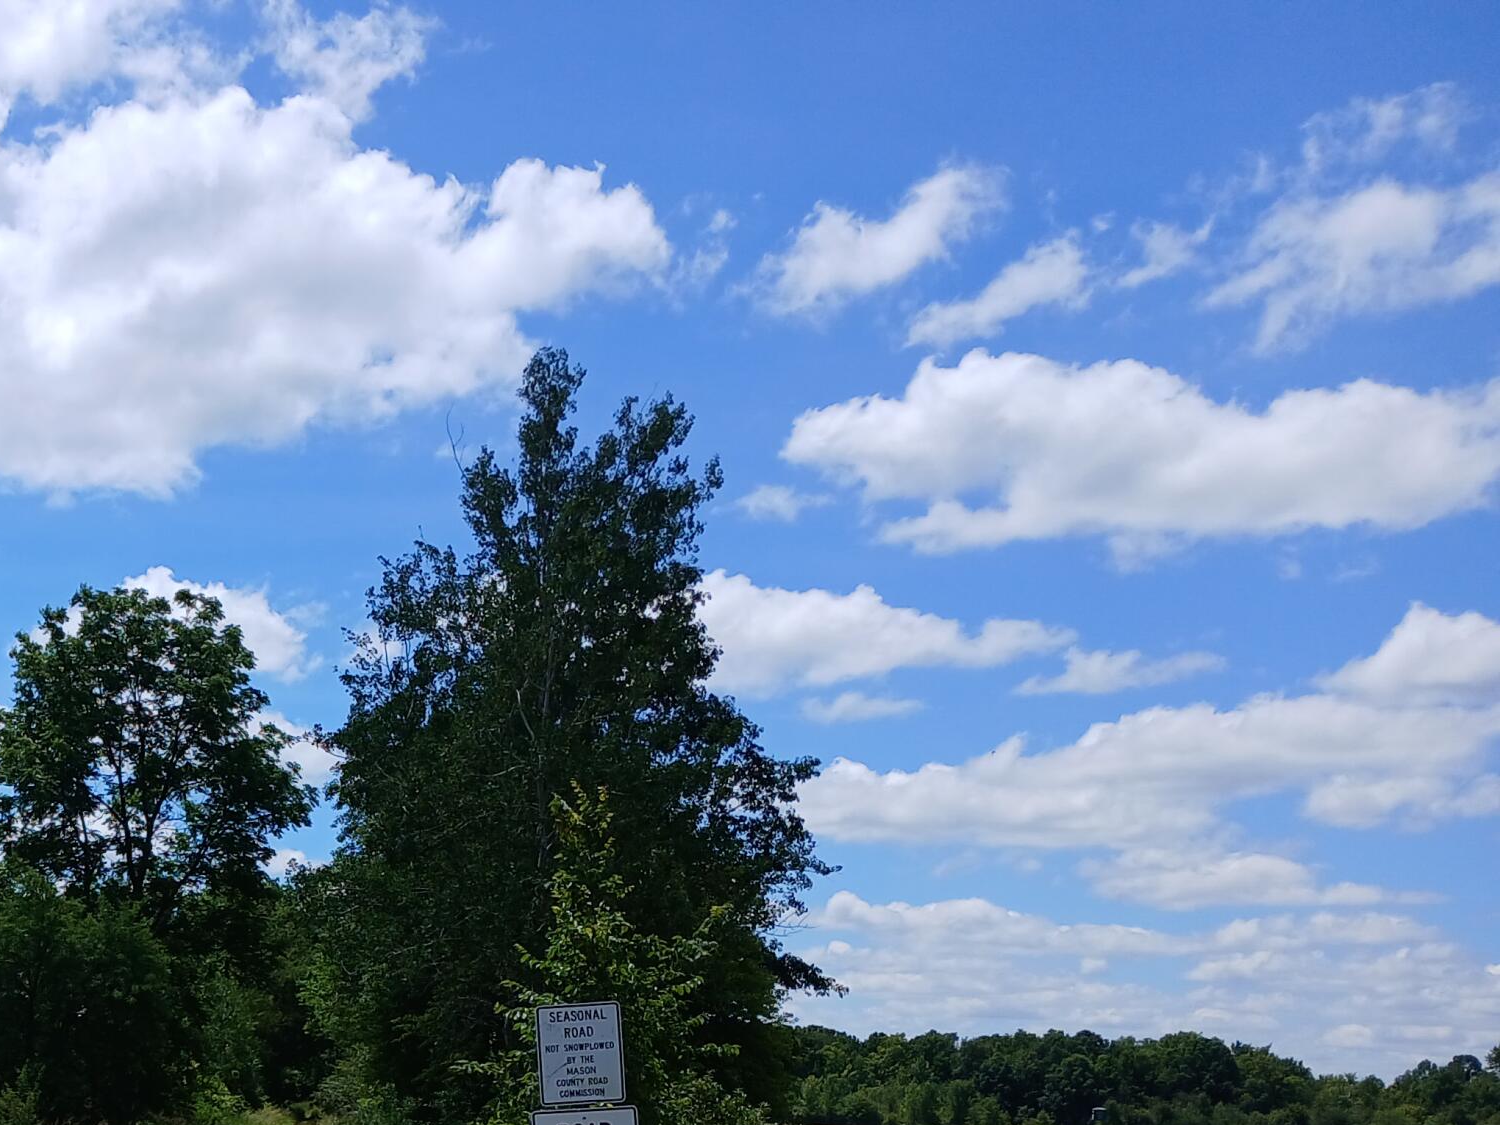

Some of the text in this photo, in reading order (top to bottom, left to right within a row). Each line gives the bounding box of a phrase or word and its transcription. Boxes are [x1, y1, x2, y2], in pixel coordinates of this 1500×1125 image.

[549, 1008, 607, 1023] SEASONAL
[564, 1026, 594, 1039] ROAD
[545, 1041, 614, 1053] NOT SNOWPLOWED
[566, 1055, 595, 1064] BY THE
[566, 1066, 597, 1075] MASON
[556, 1076, 609, 1087] COUNTY ROAD
[559, 1088, 605, 1098] COMMISSION
